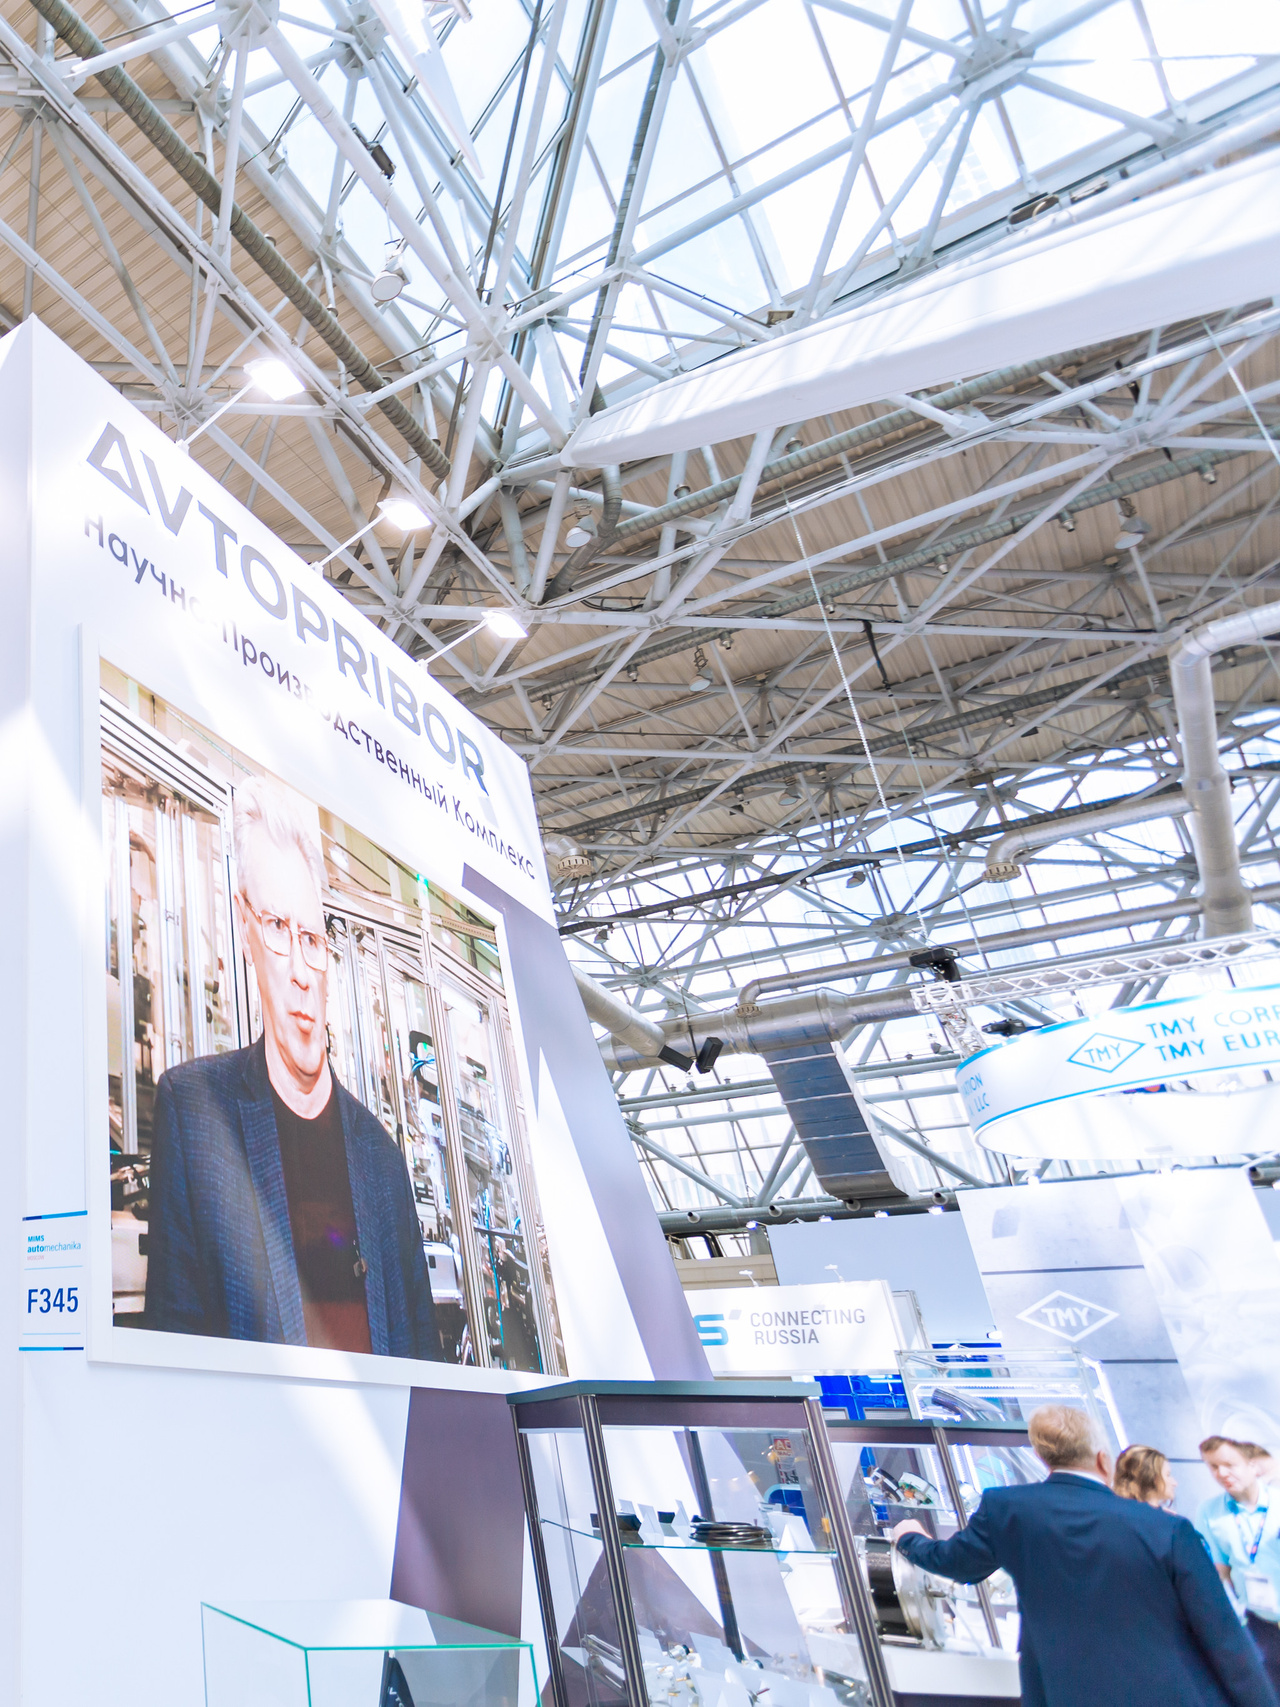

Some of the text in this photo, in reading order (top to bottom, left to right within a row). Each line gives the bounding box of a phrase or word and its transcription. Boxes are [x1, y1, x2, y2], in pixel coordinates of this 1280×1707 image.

[86, 422, 490, 796] AVTOPRIBOR
[452, 795, 535, 880] Комплекс
[1146, 1015, 1196, 1039] TMY
[1083, 1042, 1122, 1064] TMY
[1154, 1038, 1206, 1062] TMY
[27, 1235, 45, 1243] MIMS
[27, 1242, 82, 1253] automechanika
[27, 1287, 79, 1314] F345
[750, 1308, 866, 1328] CONNECTING
[1040, 1306, 1089, 1327] TMY
[754, 1328, 820, 1346] RUSSIA
